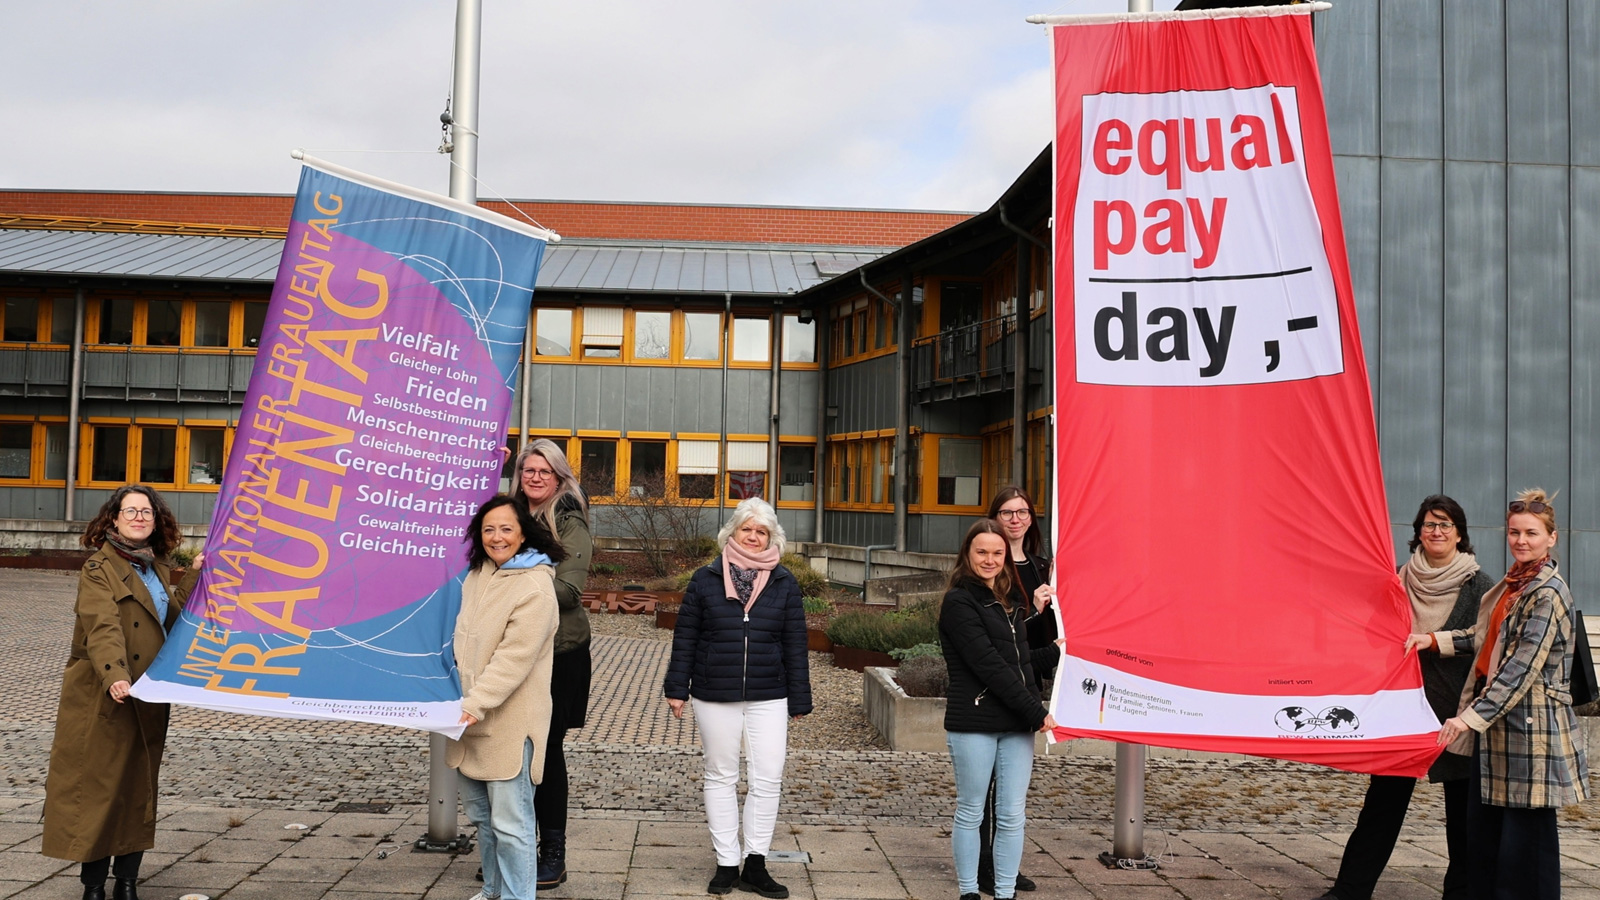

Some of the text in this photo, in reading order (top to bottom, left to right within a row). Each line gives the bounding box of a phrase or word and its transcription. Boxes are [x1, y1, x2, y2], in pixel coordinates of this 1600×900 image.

[1093, 92, 1295, 190] equal
[1093, 197, 1228, 270] pay
[381, 322, 460, 361] Vielfalt
[1093, 291, 1237, 377] day
[389, 352, 478, 385] Gleicher Lohn
[405, 376, 488, 412] Frieden
[346, 406, 497, 452] Menschenrechte
[373, 393, 499, 433] Selbstbestimmung
[176, 191, 343, 681] INTERNATIONALER FRAUENTAG
[359, 434, 499, 471] Gleichberechtigung
[204, 261, 389, 699] FRAUENTAG
[334, 448, 490, 491] Gerechtigkeit
[355, 484, 479, 517] Solidarität
[358, 514, 465, 538] Gewaltfreiheit
[339, 531, 447, 559] Gleichheit
[1106, 648, 1154, 667] gefördert vom
[291, 699, 419, 712] Gleichberechtigung
[331, 708, 428, 718] Vernetzung e.V.
[1109, 694, 1118, 702] für
[1119, 696, 1145, 709] Familie,
[1110, 685, 1171, 705] Bundesministerium
[1122, 705, 1147, 716] Jugend
